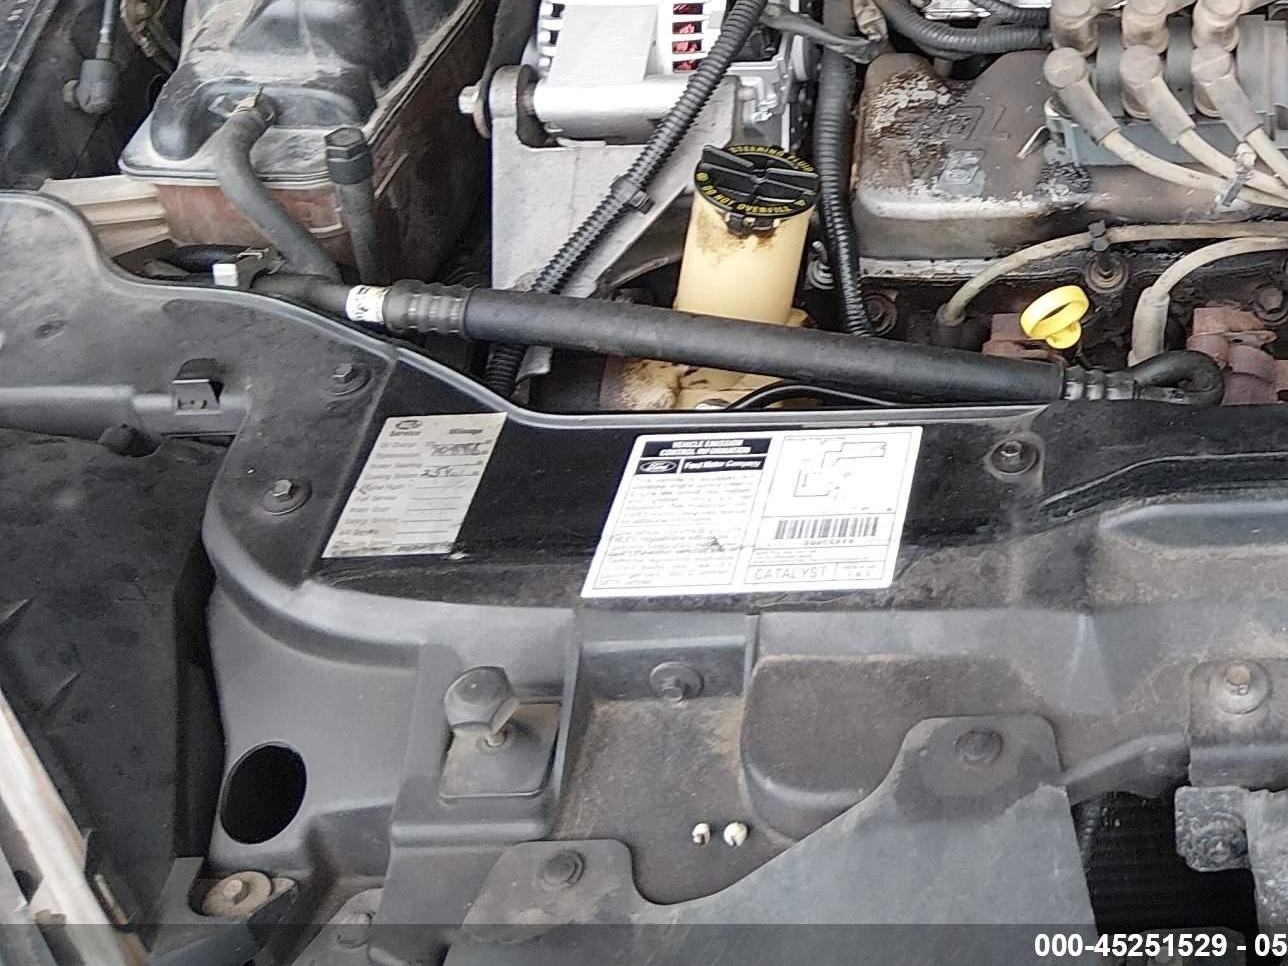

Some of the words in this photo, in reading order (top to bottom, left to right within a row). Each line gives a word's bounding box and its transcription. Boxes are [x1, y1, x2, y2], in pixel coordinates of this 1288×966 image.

[728, 145, 785, 158] STEERING
[787, 155, 814, 172] FLUID
[702, 185, 717, 195] DO
[713, 193, 736, 206] NOT
[736, 203, 793, 213] OVERFILL
[754, 566, 827, 581] CATALYST
